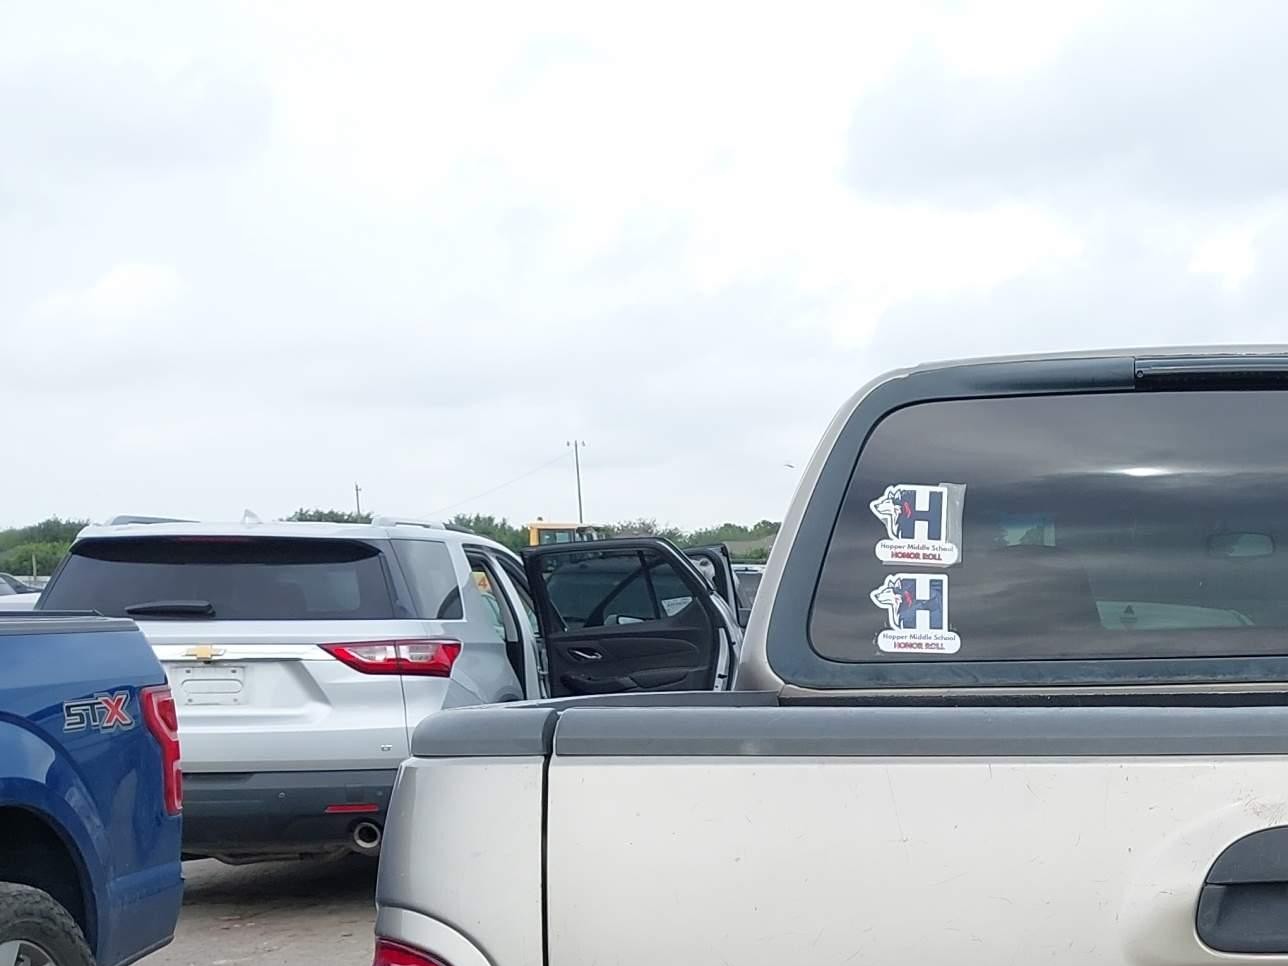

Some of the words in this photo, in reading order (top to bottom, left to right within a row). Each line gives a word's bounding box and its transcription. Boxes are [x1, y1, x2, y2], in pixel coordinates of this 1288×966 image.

[907, 543, 930, 551] Middle
[890, 551, 920, 560] HONOR
[922, 552, 943, 561] ROLL
[883, 633, 907, 641] Hopper
[910, 633, 932, 641] Middle
[893, 641, 923, 649] HONOR
[925, 642, 945, 650] ROLL
[63, 692, 133, 731] STX
